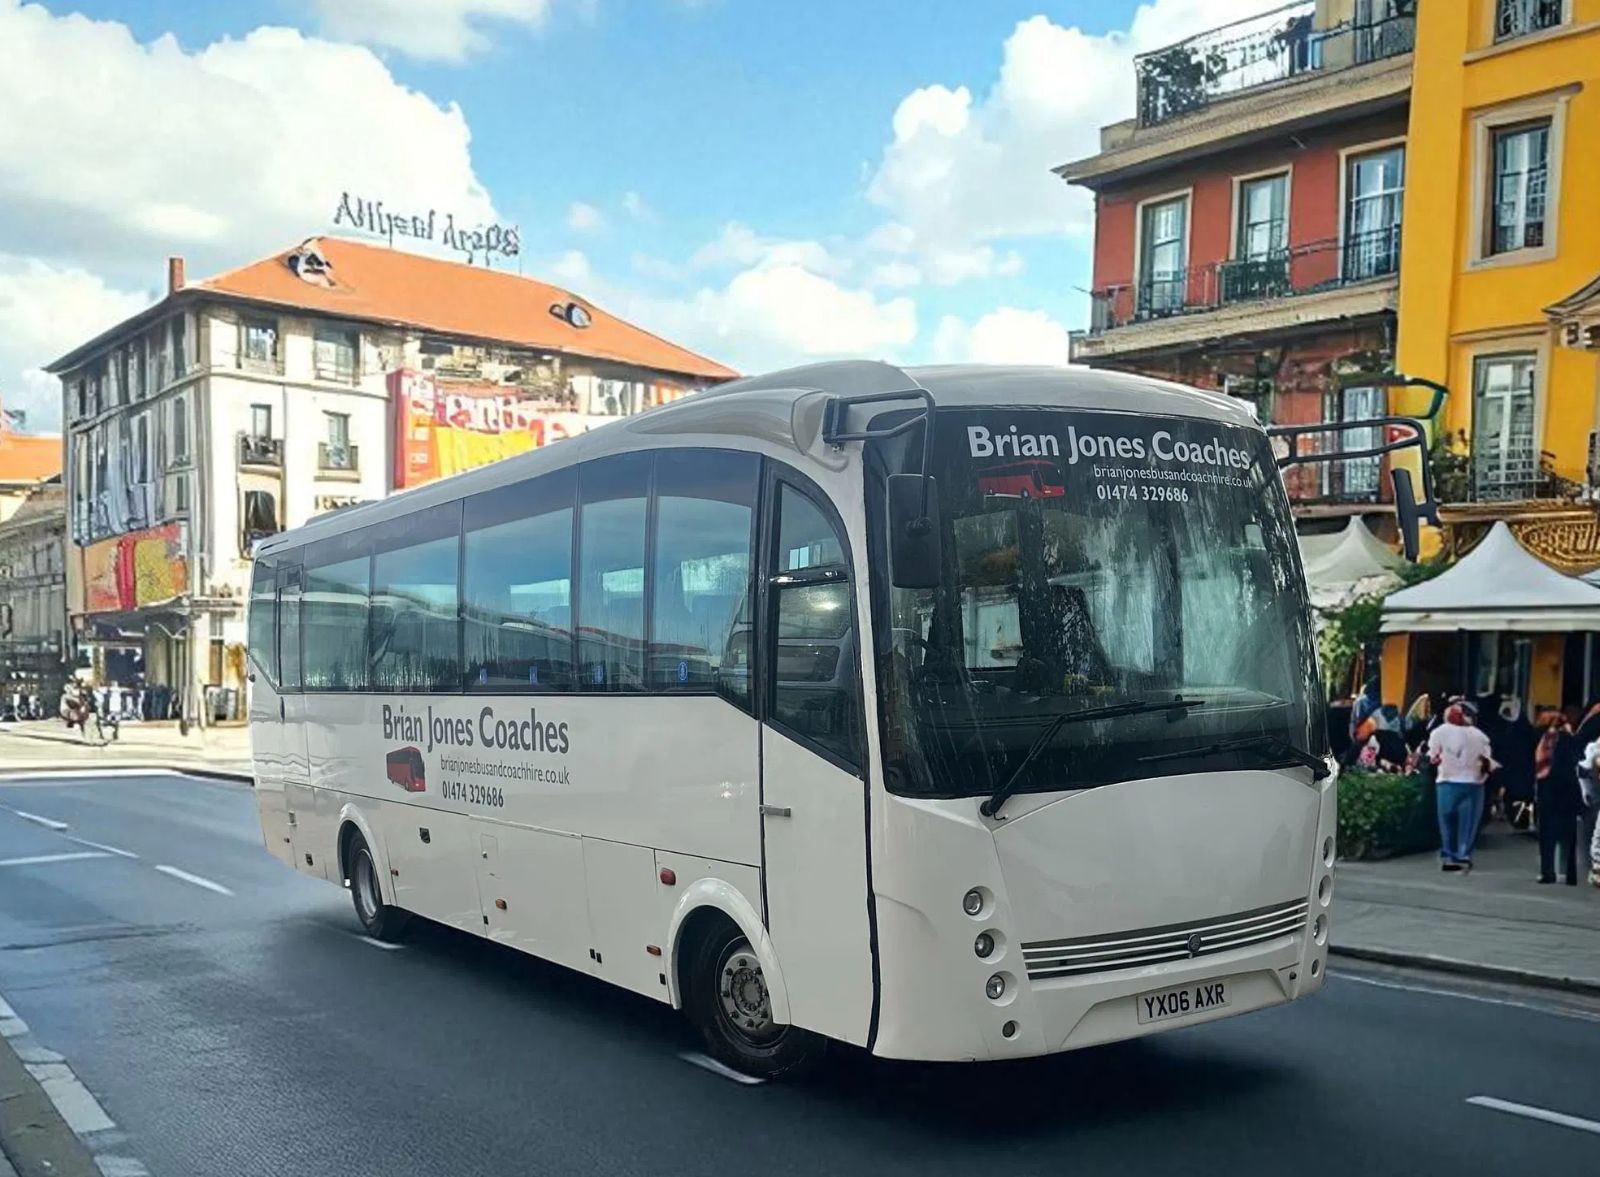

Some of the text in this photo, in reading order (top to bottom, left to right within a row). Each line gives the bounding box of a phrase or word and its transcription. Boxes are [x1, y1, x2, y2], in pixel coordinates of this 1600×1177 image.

[967, 425, 1250, 469] Brian Jones Coaches
[1094, 464, 1253, 488] brianjonesbusandcoachhire.co.uk
[1097, 485, 1188, 502] 01474 329686
[383, 704, 569, 753] Brian Jones Coaches
[441, 754, 570, 785] brianjonesbusandcoachhire.co.uk
[442, 781, 504, 807] 01474 329686
[1145, 983, 1224, 1018] YX06 AXR
